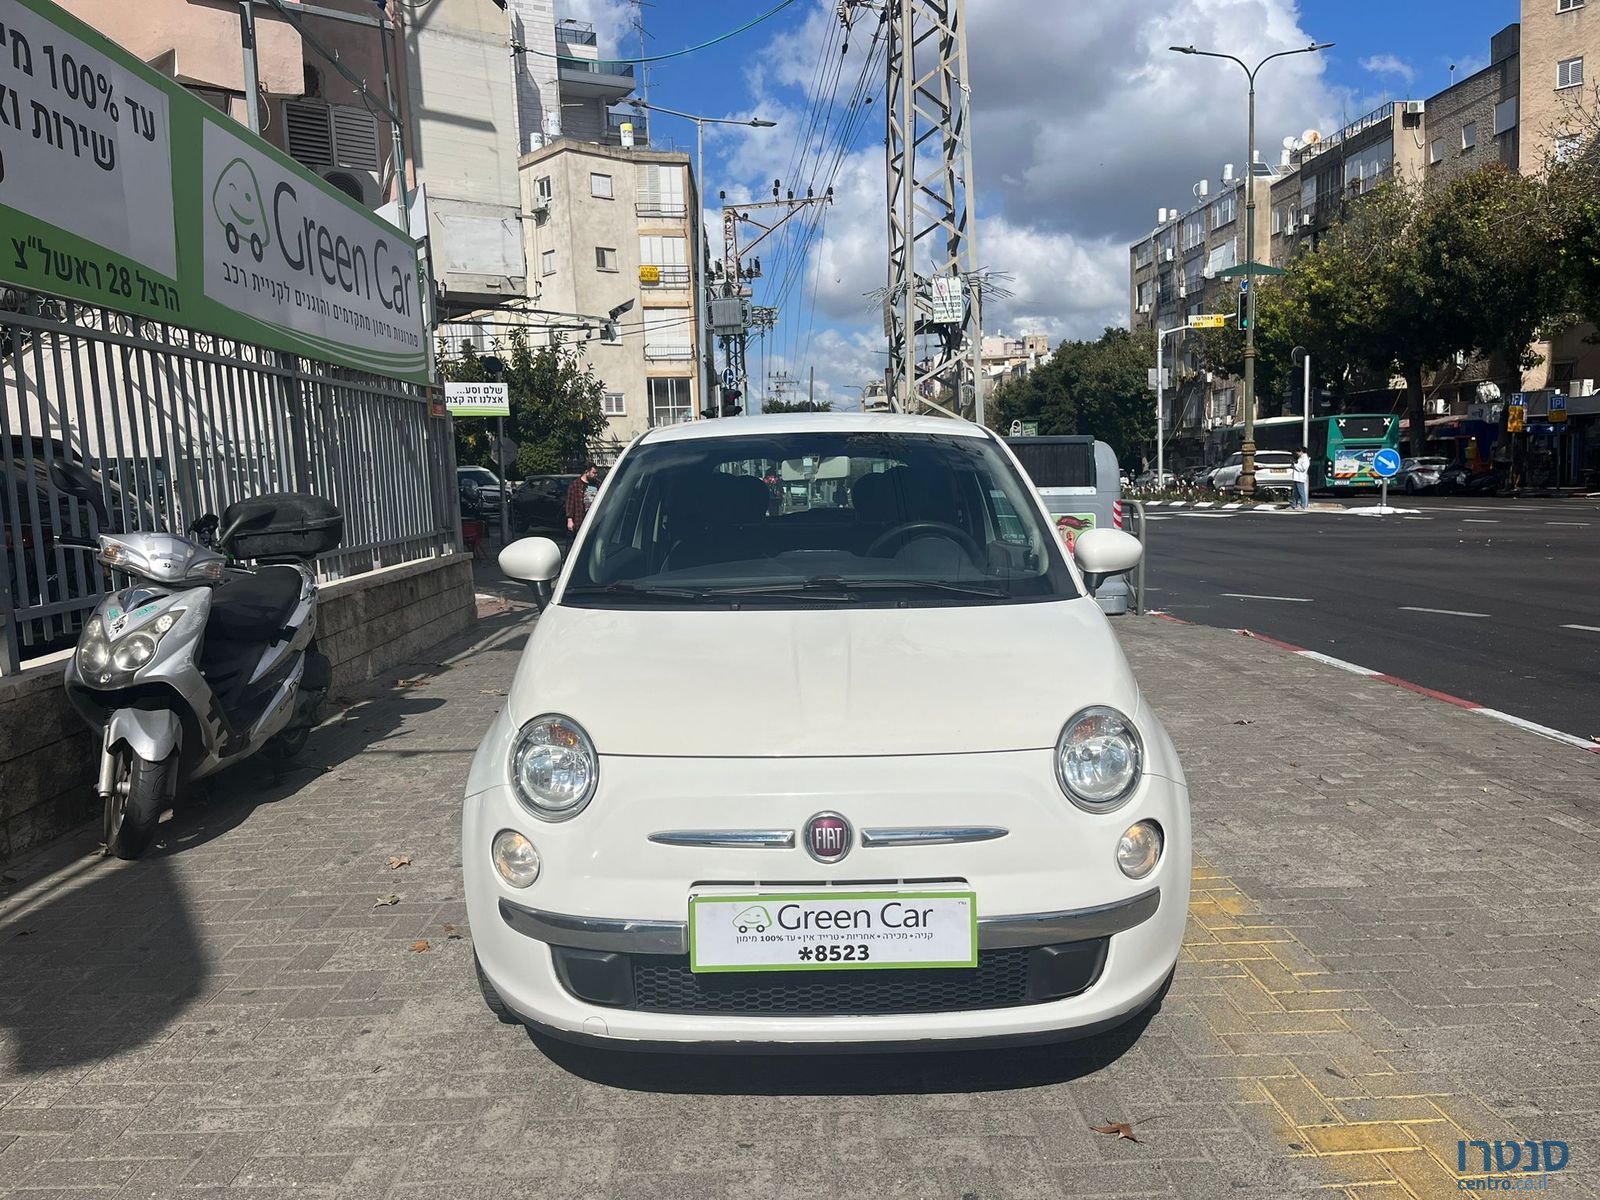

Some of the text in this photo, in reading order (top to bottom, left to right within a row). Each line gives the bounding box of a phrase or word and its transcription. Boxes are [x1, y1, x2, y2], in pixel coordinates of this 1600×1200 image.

[43, 45, 119, 123] 100%
[125, 96, 155, 142] עד
[30, 99, 115, 171] שירות
[273, 181, 411, 317] Green Car
[107, 262, 132, 298] 28
[136, 270, 180, 312] הרצל
[223, 261, 418, 347] פתרונות מימון מתקדמים והוגנים לקניית רכב
[445, 396, 465, 405] קצת
[456, 386, 503, 394] שלם וסע...
[480, 395, 504, 403] אצלנו
[815, 827, 843, 849] FIAT
[777, 902, 934, 930] Green Car
[736, 935, 757, 944] מימון
[803, 934, 815, 942] אין
[882, 932, 907, 940] מכירה
[914, 932, 934, 940] קניה
